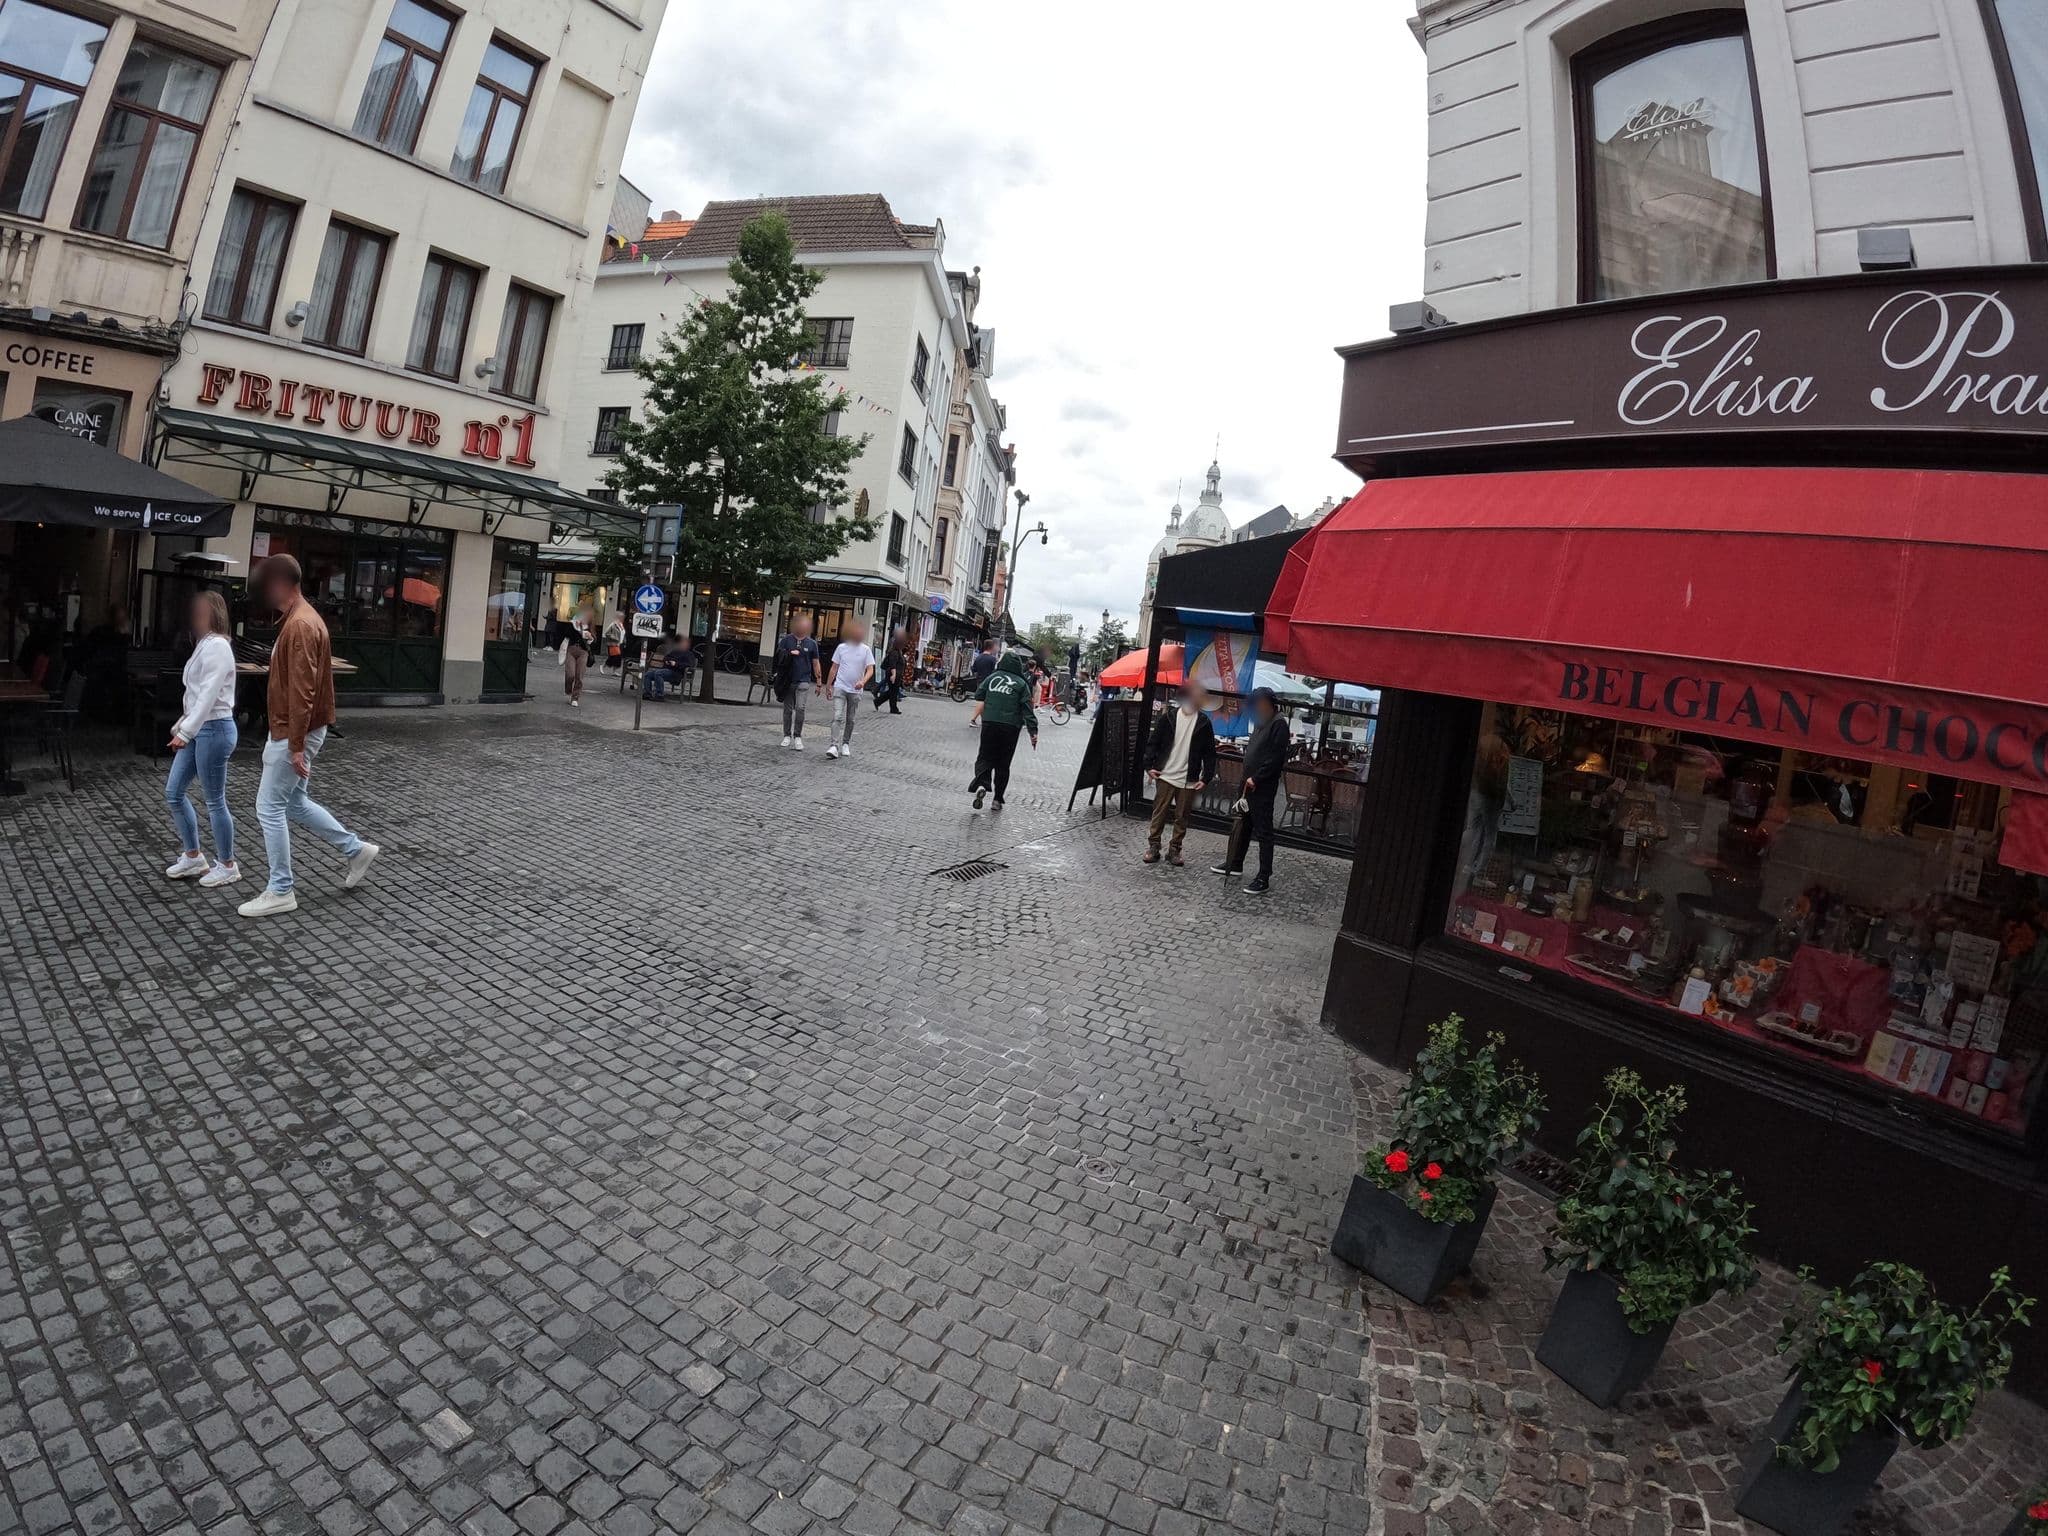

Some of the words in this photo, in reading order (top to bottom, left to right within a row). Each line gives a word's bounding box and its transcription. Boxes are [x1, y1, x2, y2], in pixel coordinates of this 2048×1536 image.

[1624, 96, 1705, 132] Elisa
[6, 344, 94, 375] COFFEE
[1617, 315, 1818, 425] Elisa
[1869, 290, 2048, 415] Pra
[54, 409, 102, 428] CARNE
[197, 362, 441, 447] FRITUUR
[94, 506, 110, 516] We
[112, 509, 141, 518] serve
[154, 512, 171, 521] ICE
[173, 513, 202, 523] COLD
[1558, 661, 1816, 736] BELGIAN
